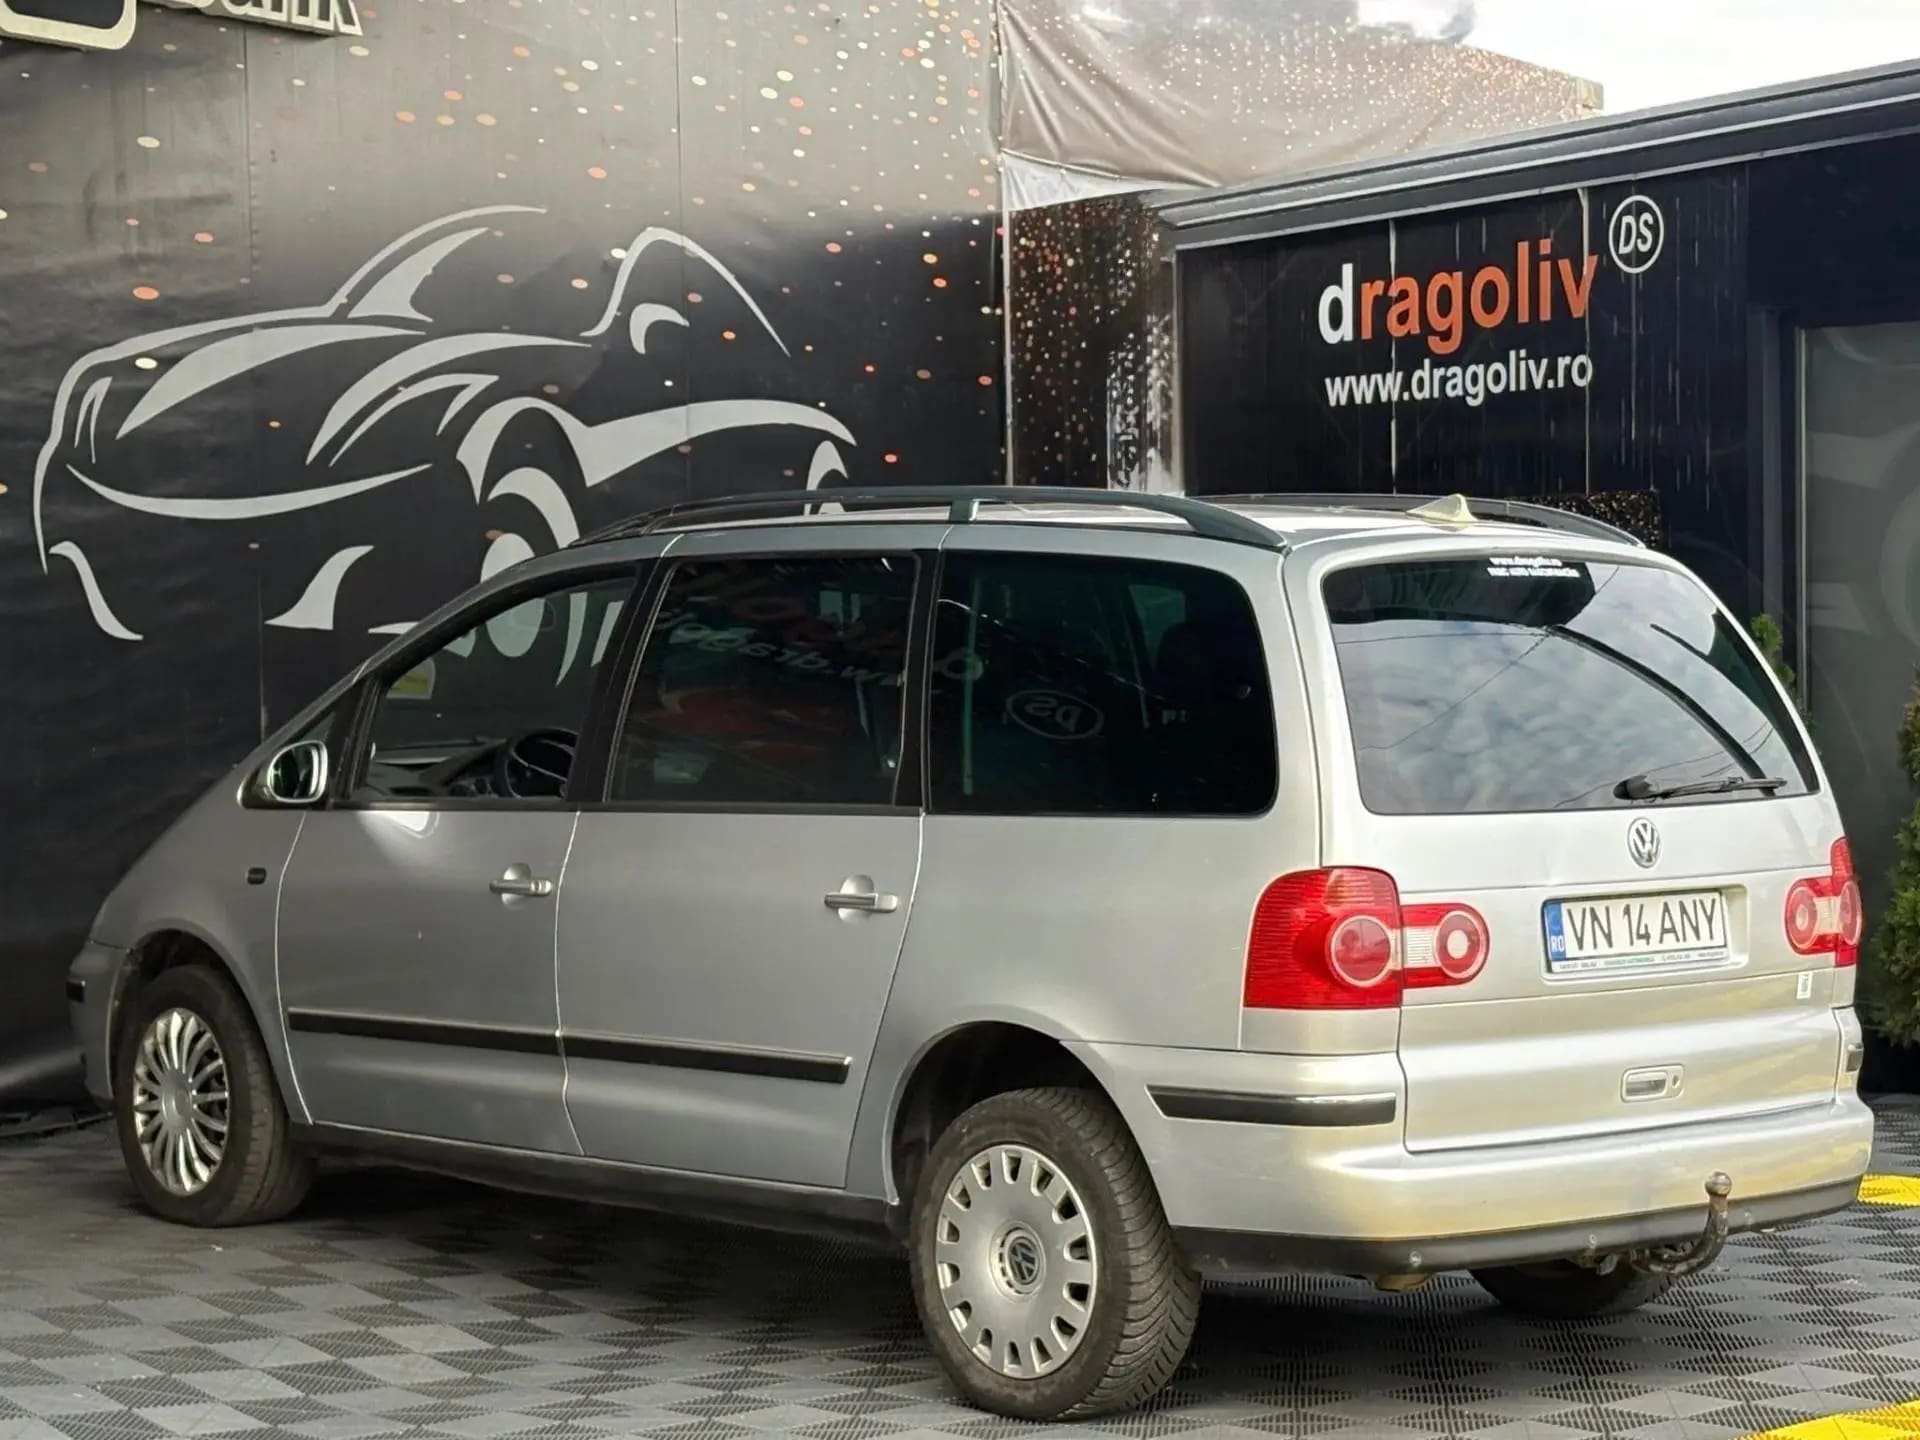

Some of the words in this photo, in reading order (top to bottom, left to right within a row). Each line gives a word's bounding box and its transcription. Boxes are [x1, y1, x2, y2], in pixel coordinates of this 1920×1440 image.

[1618, 212, 1654, 254] DS
[1318, 238, 1599, 354] dragoliv
[1324, 349, 1593, 407] www.dragoliv.ro
[1550, 935, 1565, 951] RO
[1566, 906, 1614, 951] VN
[1622, 903, 1651, 946] 14
[1658, 898, 1717, 944] ANY
